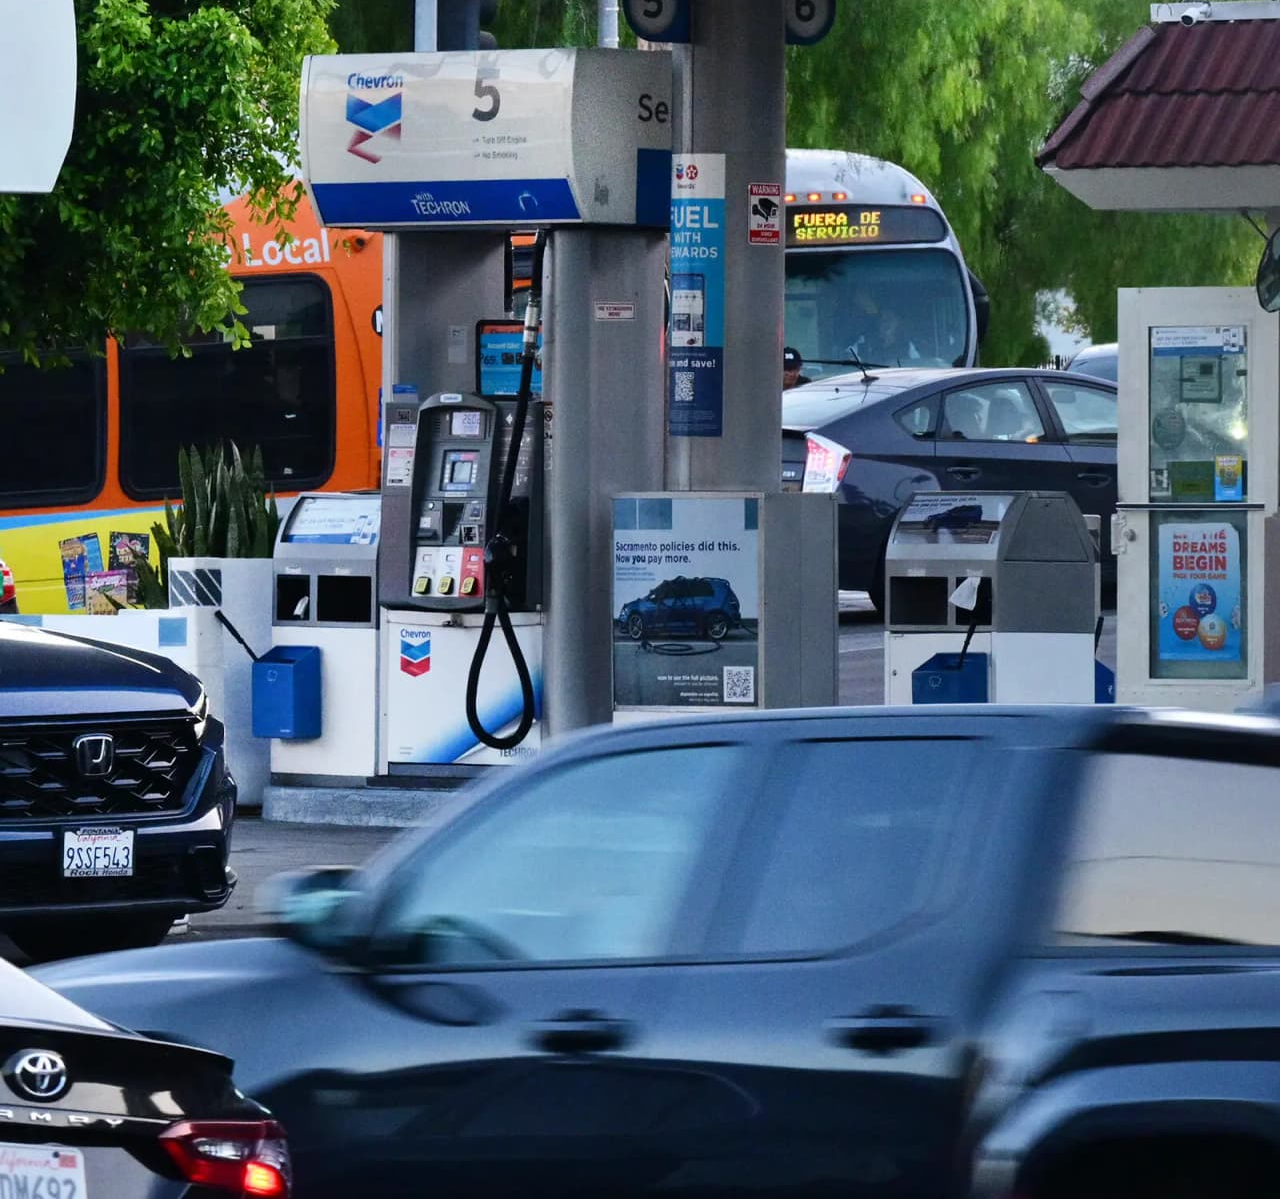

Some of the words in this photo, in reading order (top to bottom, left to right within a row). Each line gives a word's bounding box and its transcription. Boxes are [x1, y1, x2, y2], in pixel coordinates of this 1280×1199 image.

[347, 72, 404, 91] Chevron
[471, 62, 501, 122] 5
[752, 185, 779, 194] WARNING
[415, 192, 434, 202] with
[411, 197, 471, 217] TECHRON
[671, 206, 719, 229] UEL
[794, 212, 848, 227] FUERA
[860, 211, 881, 224] DE
[674, 232, 701, 243] WITH
[795, 225, 879, 240] SERVICIO
[242, 228, 330, 267] Local
[671, 247, 718, 259] EWARDS
[691, 359, 716, 368] save!
[616, 541, 658, 552] Sacramento
[660, 541, 695, 553] policies
[698, 541, 715, 551] did
[717, 541, 741, 551] this.
[1173, 542, 1227, 553] DREAMS
[616, 554, 631, 563] Now
[632, 555, 646, 565] you
[647, 555, 663, 565] pay
[664, 555, 691, 563] more.
[1173, 556, 1227, 571] BEGIN
[400, 628, 431, 639] Chevron
[66, 846, 130, 870] 9SSF543
